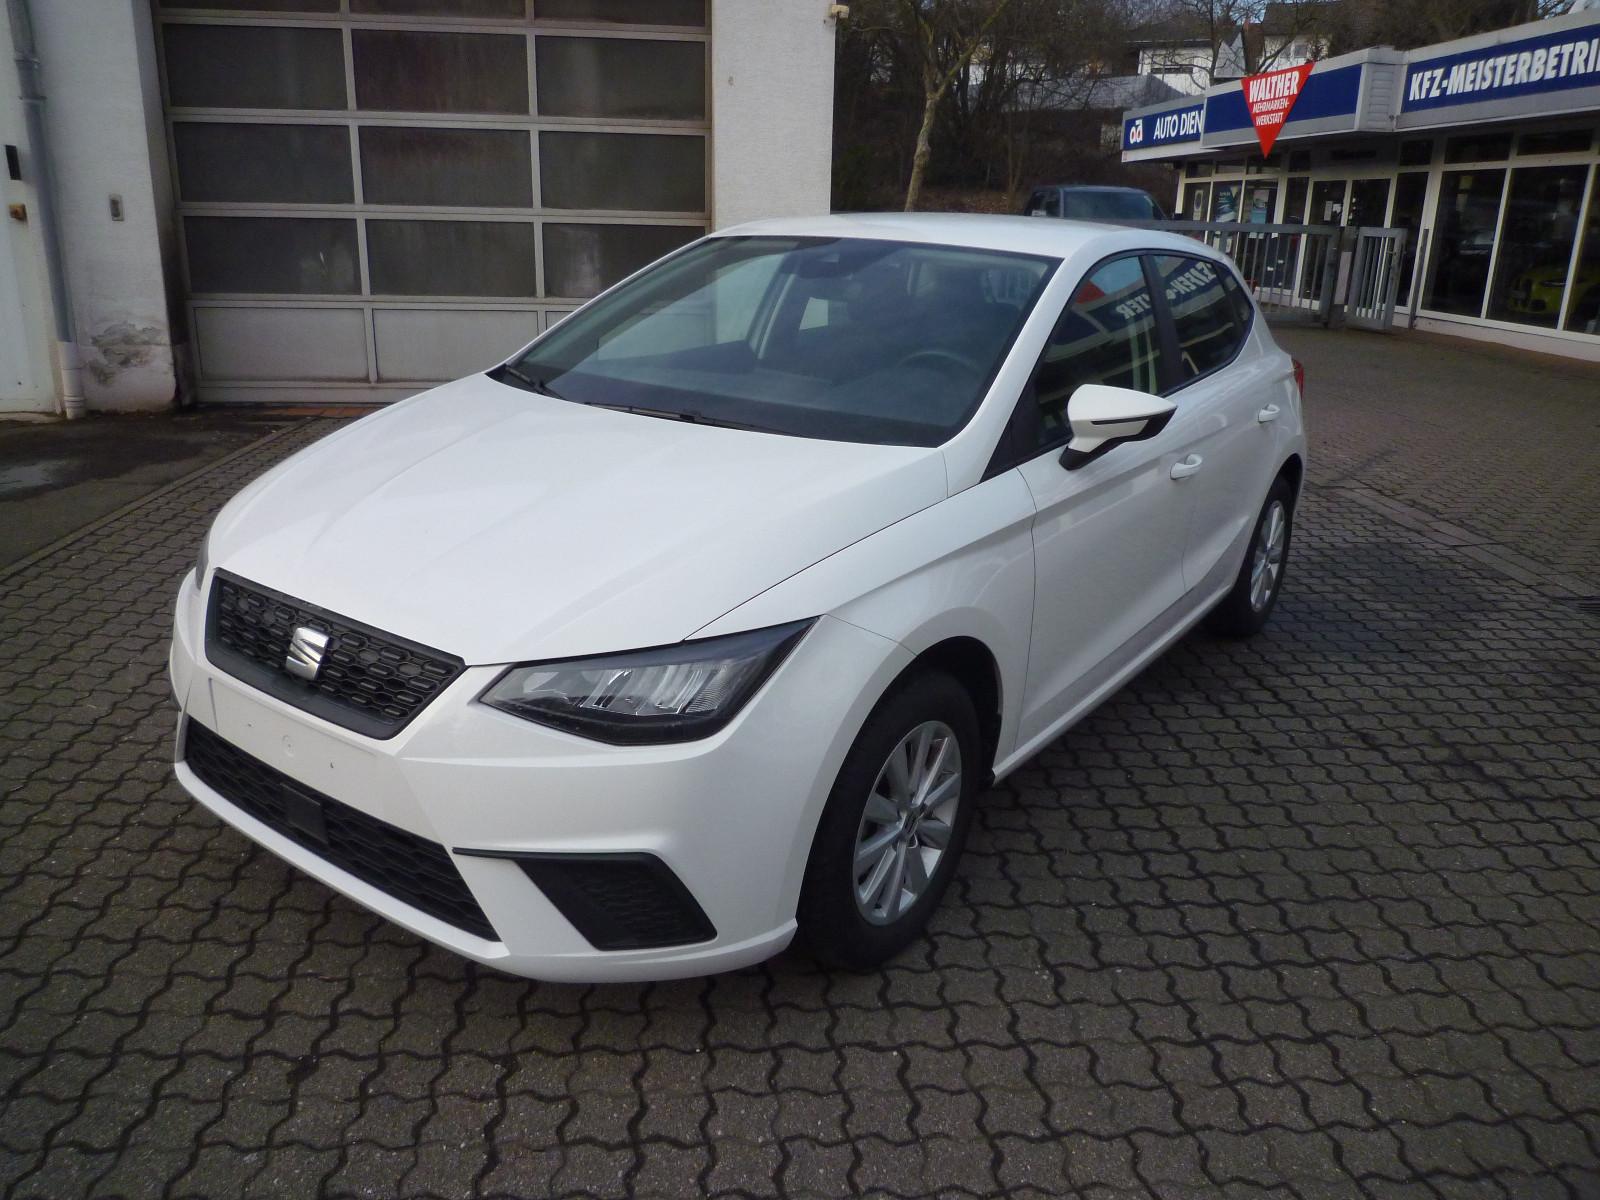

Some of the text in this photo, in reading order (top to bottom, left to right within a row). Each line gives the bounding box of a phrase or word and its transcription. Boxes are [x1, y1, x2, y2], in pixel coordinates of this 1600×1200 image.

[1249, 70, 1299, 103] WALTHER
[1153, 114, 1179, 140] AUTO
[1255, 111, 1284, 126] WERKSTATT
